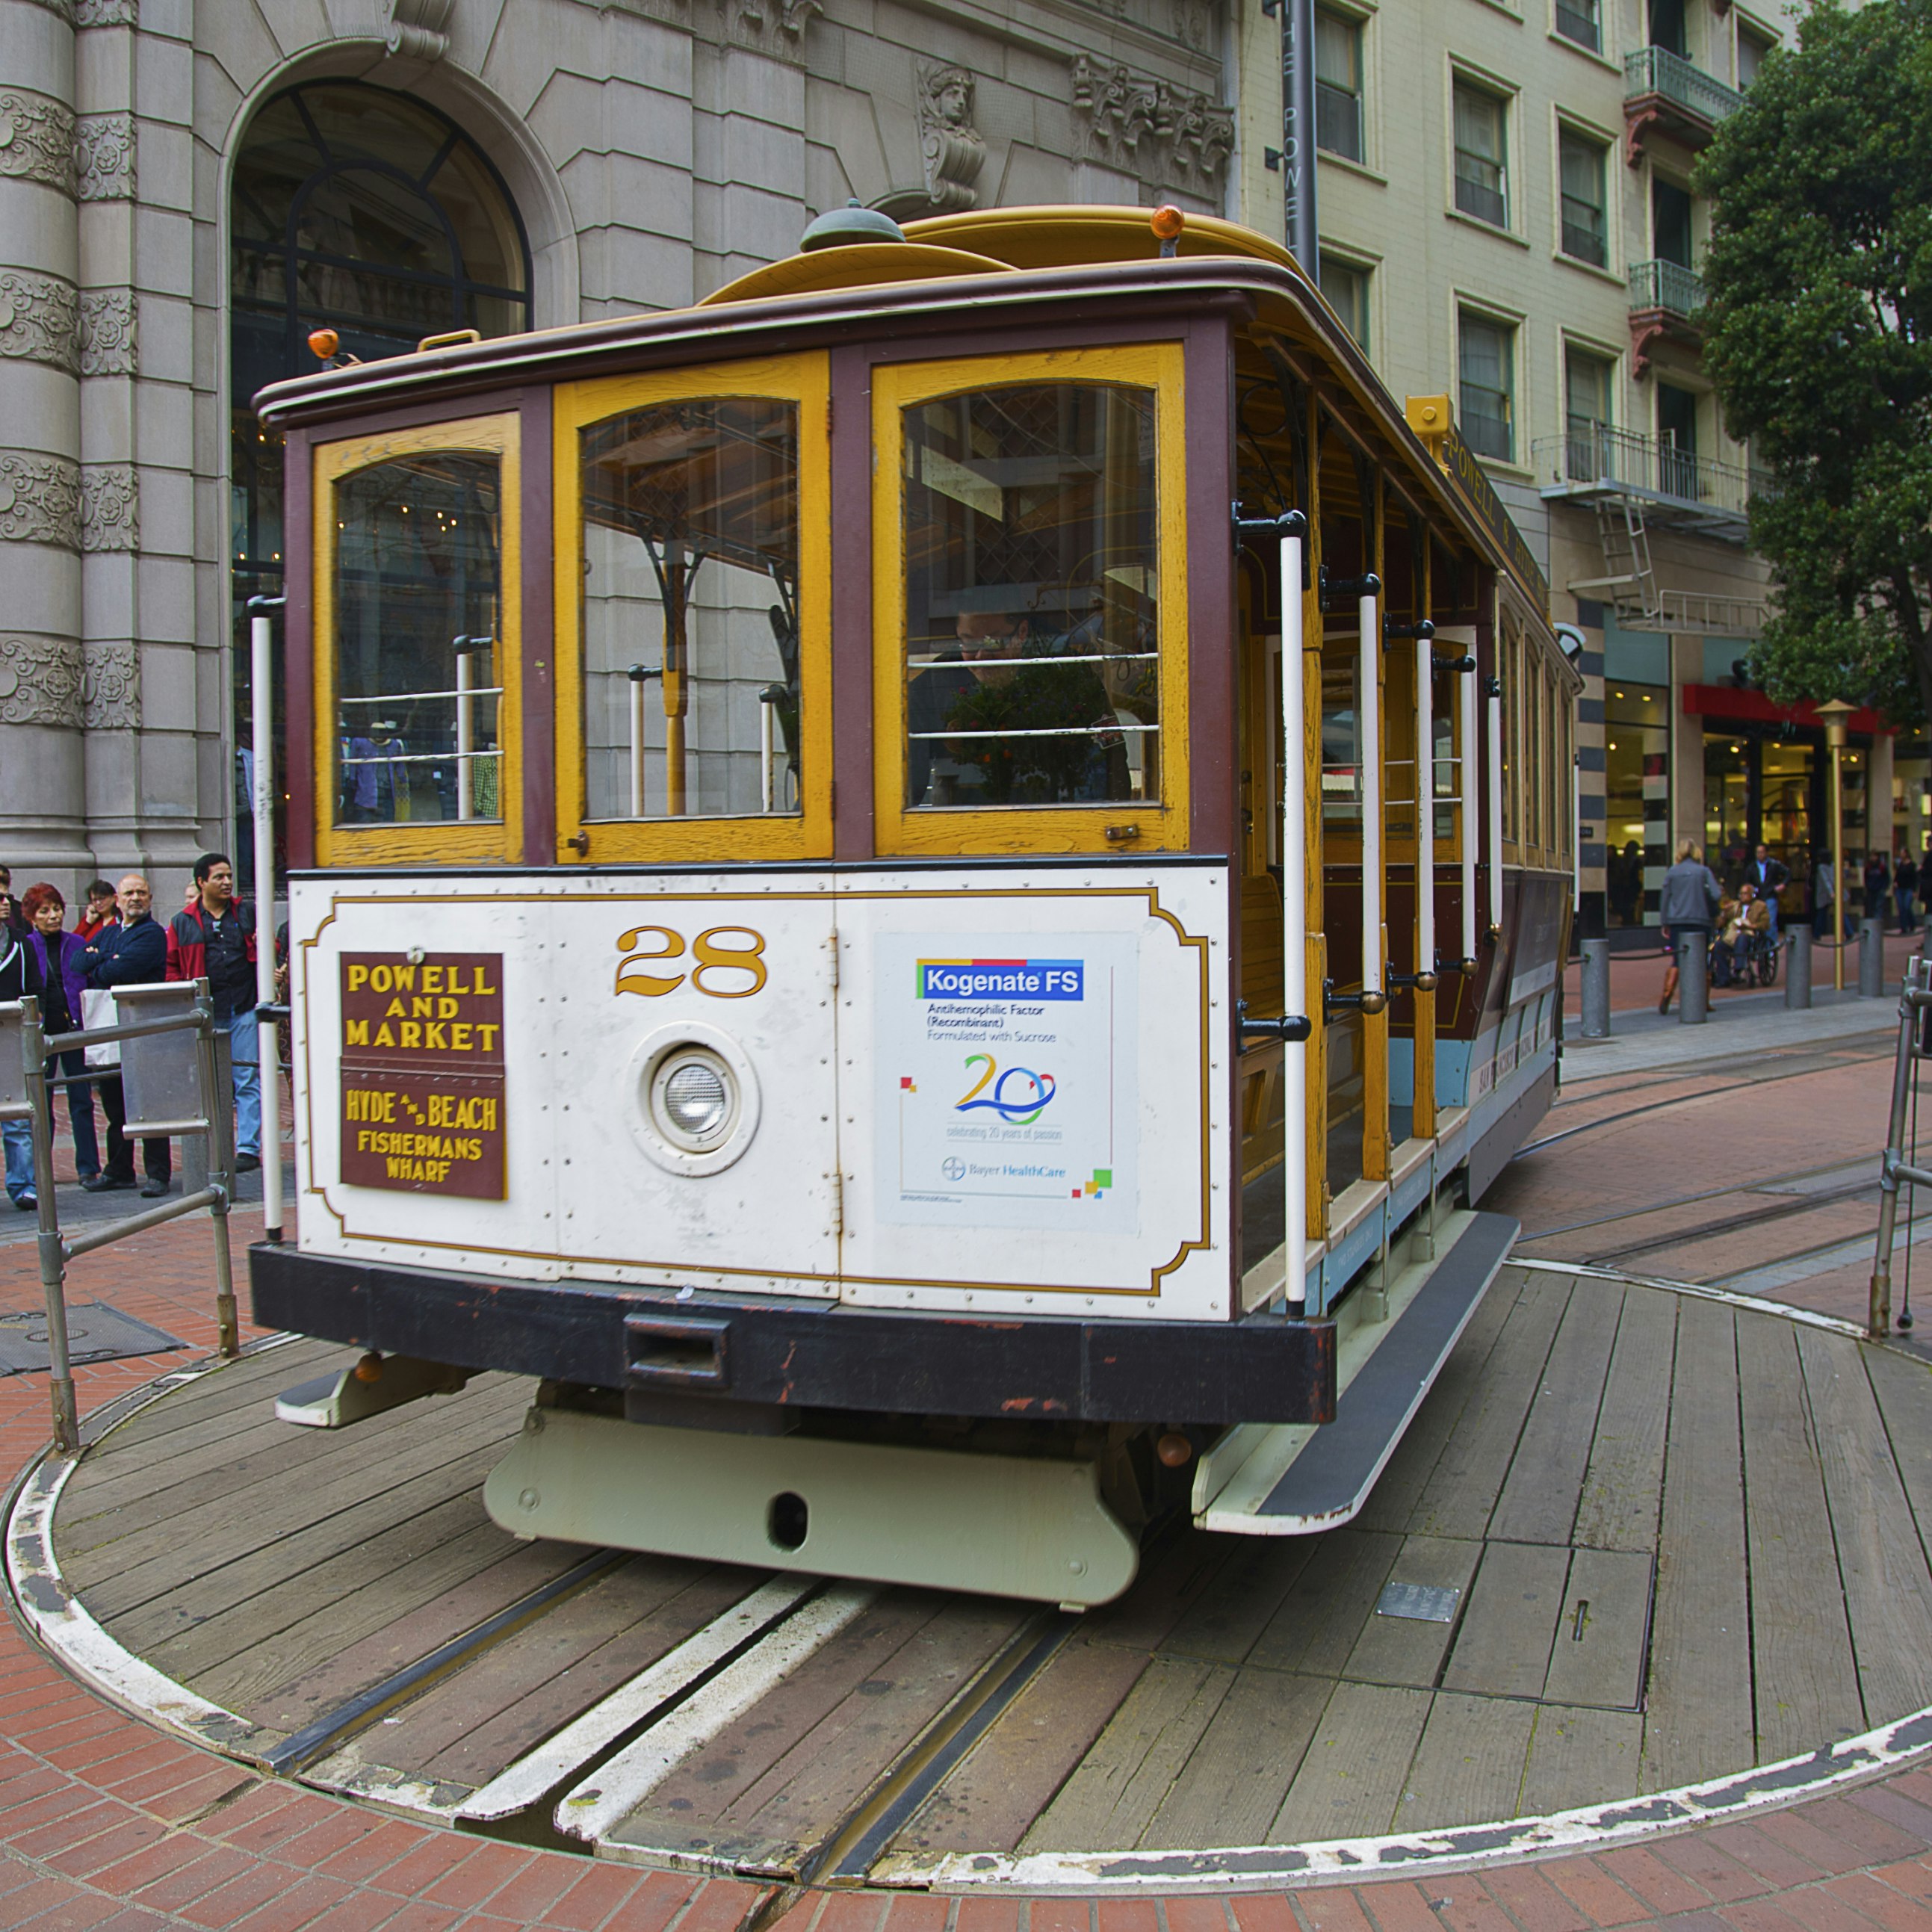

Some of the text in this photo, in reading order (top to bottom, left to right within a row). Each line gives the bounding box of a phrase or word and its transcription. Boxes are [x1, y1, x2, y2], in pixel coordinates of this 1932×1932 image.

[1284, 107, 1301, 250] POWEL
[1448, 432, 1496, 527] POWELL
[1503, 518, 1509, 549] &
[615, 925, 768, 999] 28
[347, 964, 496, 995] POWELL
[927, 969, 1079, 997] Kogenate FS
[386, 996, 460, 1020] AND
[926, 1016, 1004, 1029] (Recombinant)
[927, 1003, 1045, 1017] Antihemophilic Factor
[345, 1019, 499, 1051] MARKET
[927, 1030, 1056, 1043] Formulated with Sucrose
[954, 1053, 1056, 1125] 20
[345, 1089, 498, 1132] HYDE AND BEACH
[358, 1130, 482, 1160] FISHERMANS
[988, 1127, 999, 1139] 20
[1001, 1129, 1021, 1140] years
[1024, 1128, 1031, 1139] of
[386, 1157, 451, 1182] WHARF
[969, 1163, 1000, 1177] Bayer
[1003, 1164, 1066, 1178] HealthCare
